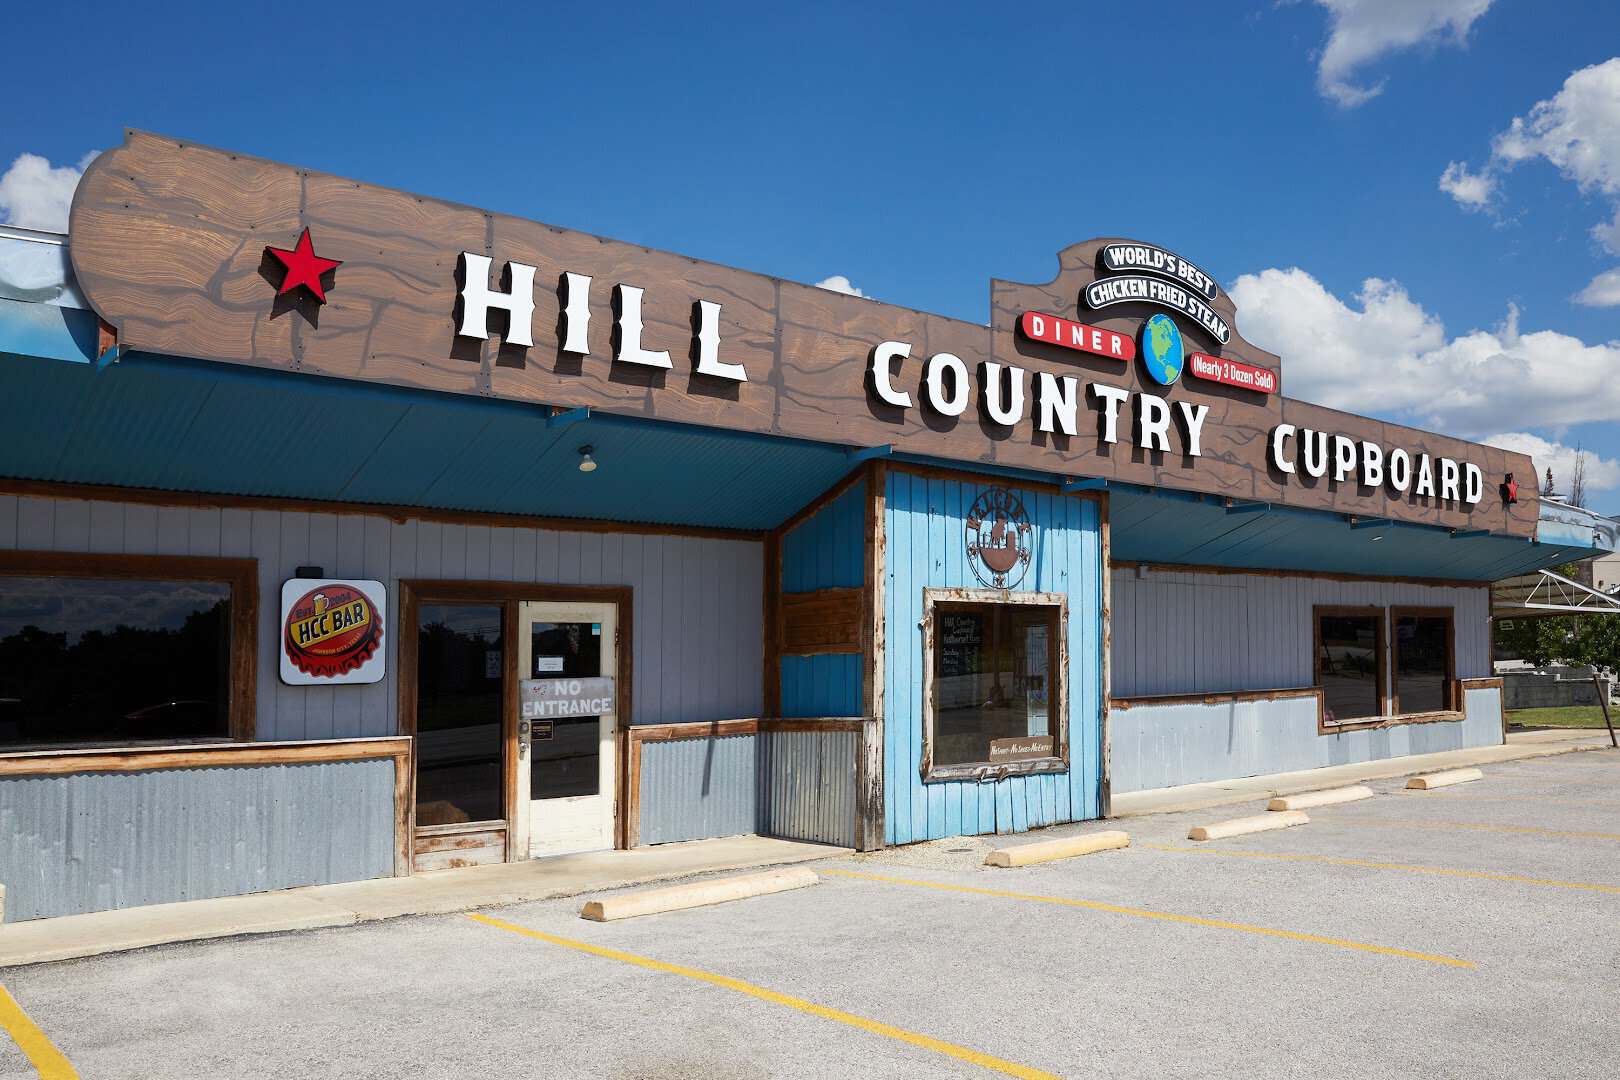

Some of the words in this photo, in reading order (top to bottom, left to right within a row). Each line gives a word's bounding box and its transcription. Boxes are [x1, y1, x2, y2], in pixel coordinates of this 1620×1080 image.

[1109, 247, 1177, 273] WORLD'S
[1177, 258, 1214, 294] BEST
[1090, 279, 1148, 305] CHICKEN
[1149, 281, 1187, 308] FRIED
[1188, 297, 1229, 341] STEAK
[1032, 316, 1122, 355] DINER
[459, 252, 748, 382] HILL
[872, 340, 1210, 457] COUNTRY
[1273, 423, 1483, 504] CUPBOARD
[1193, 355, 1223, 381] (Nearly
[1223, 363, 1229, 379] 3
[1230, 365, 1253, 385] Dozen
[298, 615, 329, 643] HCC
[332, 602, 365, 632] BAR
[522, 698, 612, 717] ENTRANCE
[555, 681, 581, 696] NO
